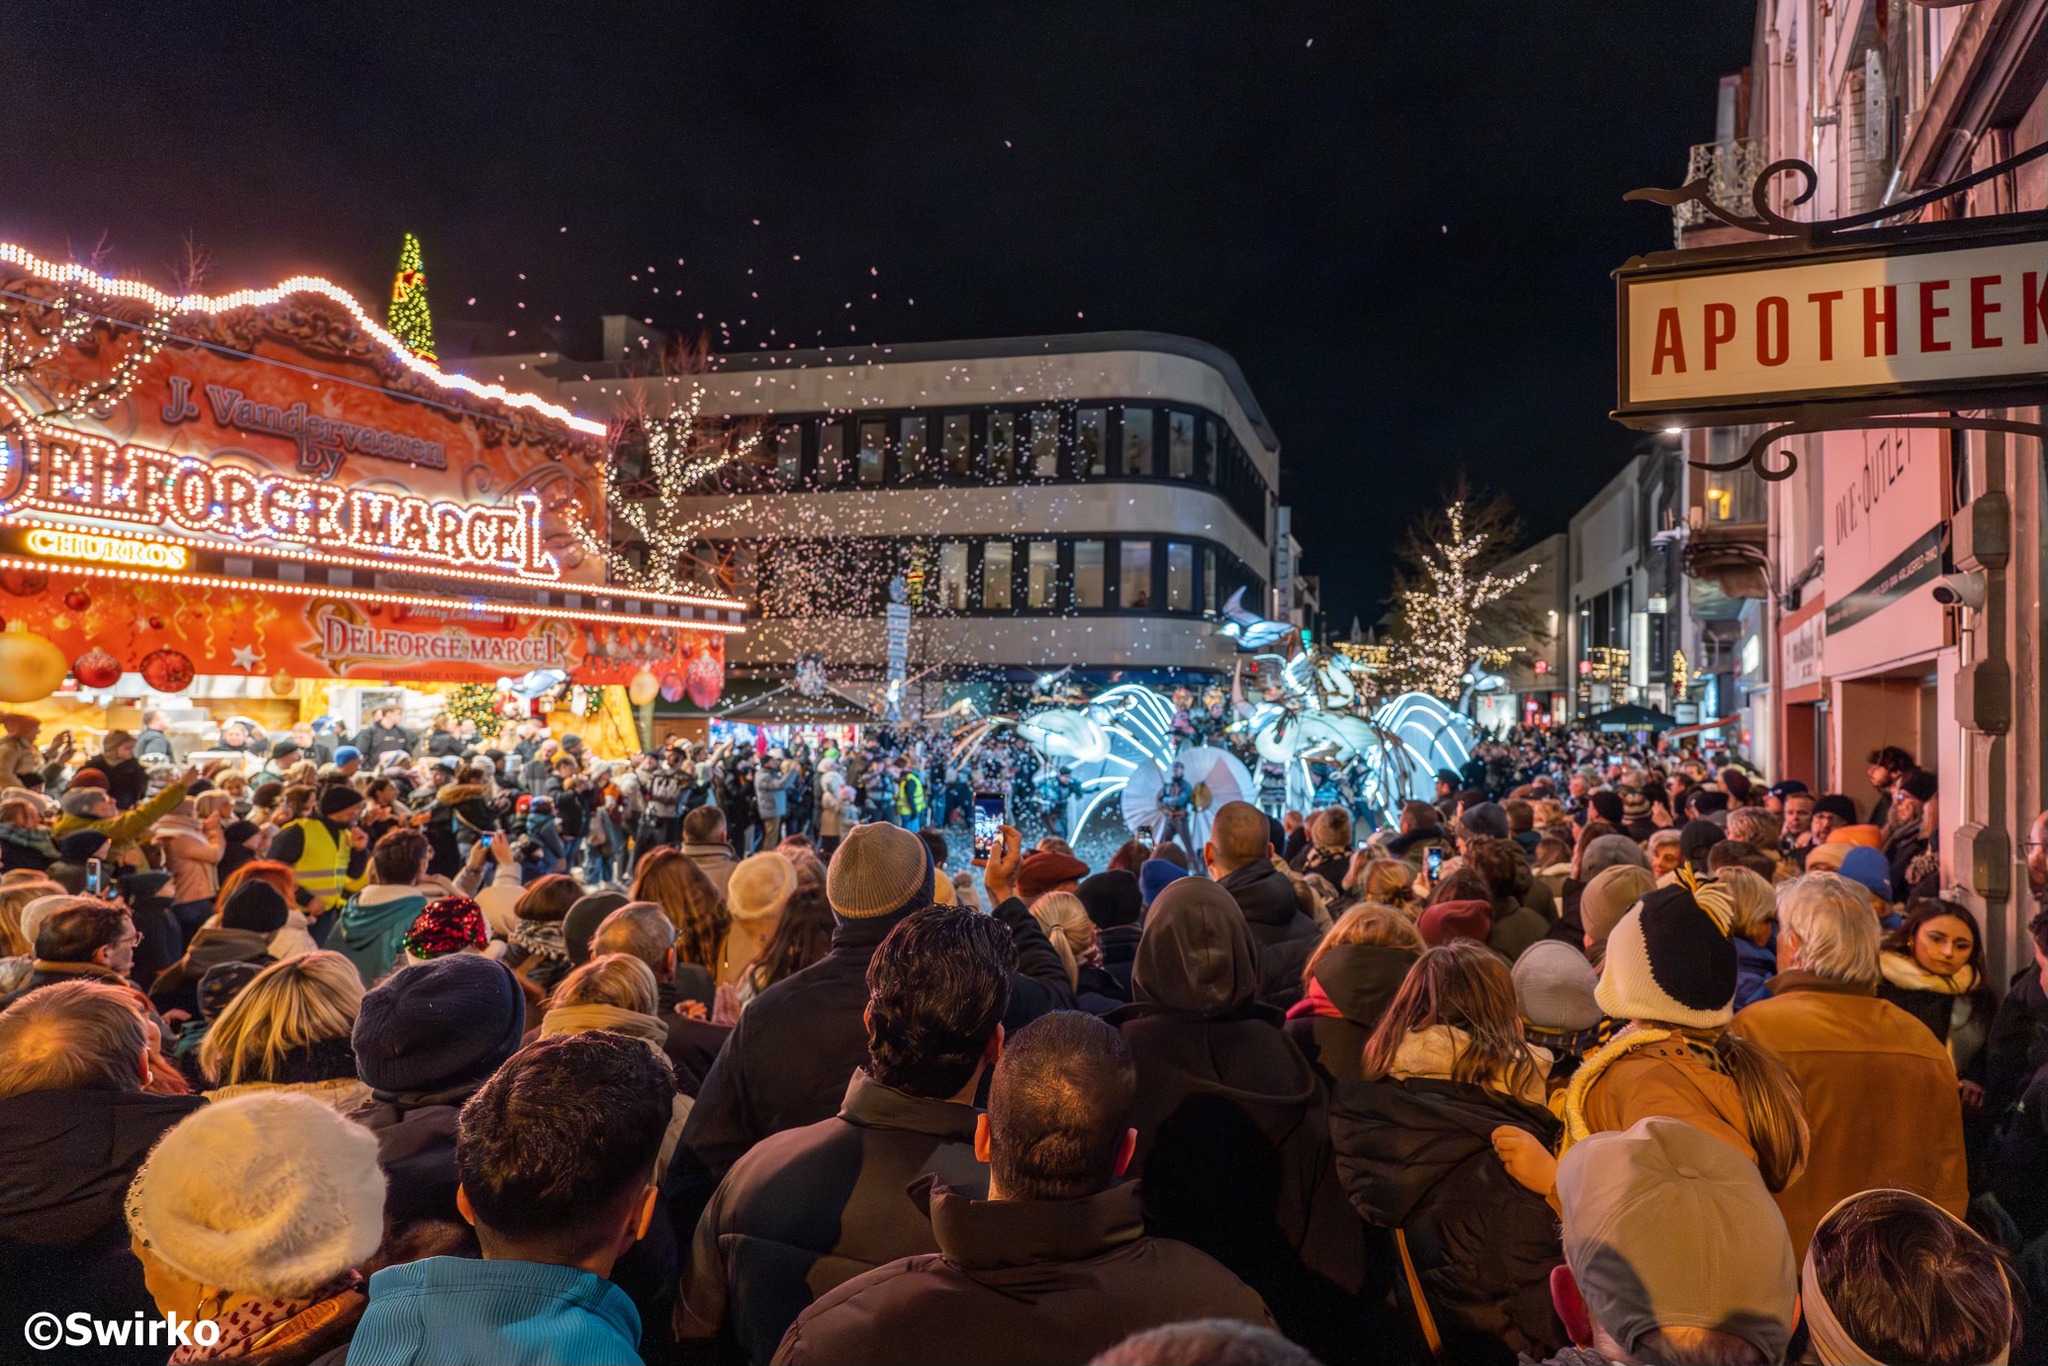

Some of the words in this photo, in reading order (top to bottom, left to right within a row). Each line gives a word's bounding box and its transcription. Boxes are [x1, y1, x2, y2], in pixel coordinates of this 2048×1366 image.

[1651, 271, 2048, 376] APOTHEEK
[162, 375, 199, 421] J.
[301, 432, 343, 480] by
[27, 529, 186, 570] CHURROS
[350, 494, 561, 580] MARCEL
[323, 615, 460, 665] DELFORGE
[468, 631, 565, 669] MARCEL
